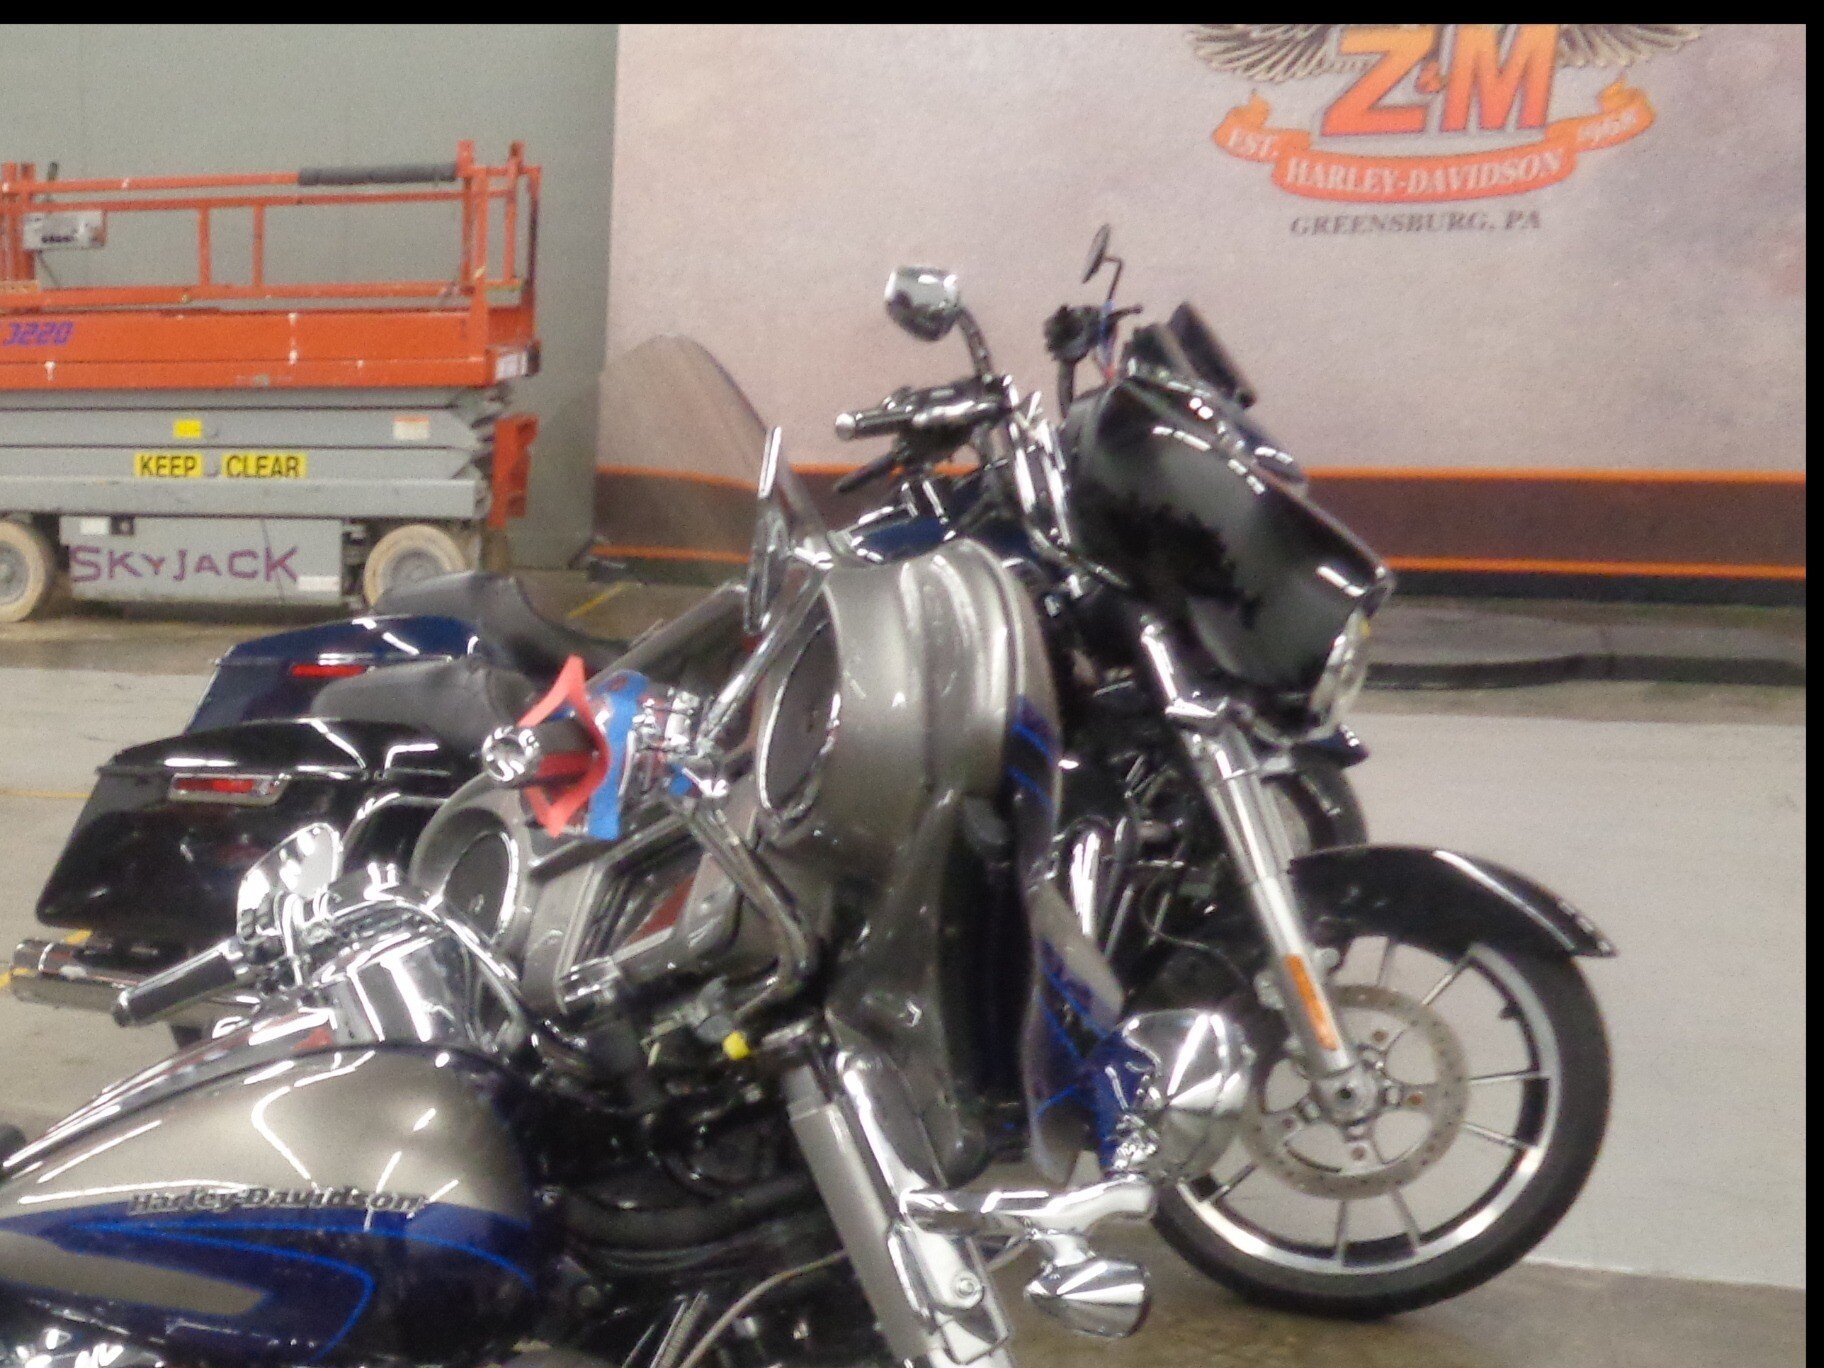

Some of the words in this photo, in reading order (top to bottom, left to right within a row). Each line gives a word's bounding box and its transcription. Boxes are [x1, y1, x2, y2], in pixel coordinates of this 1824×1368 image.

[1319, 24, 1560, 137] Z&M
[1286, 147, 1567, 197] HARLEY-DAVIDSON
[1504, 209, 1542, 231] PA
[139, 454, 197, 477] KEEP
[226, 454, 302, 478] CLEAR
